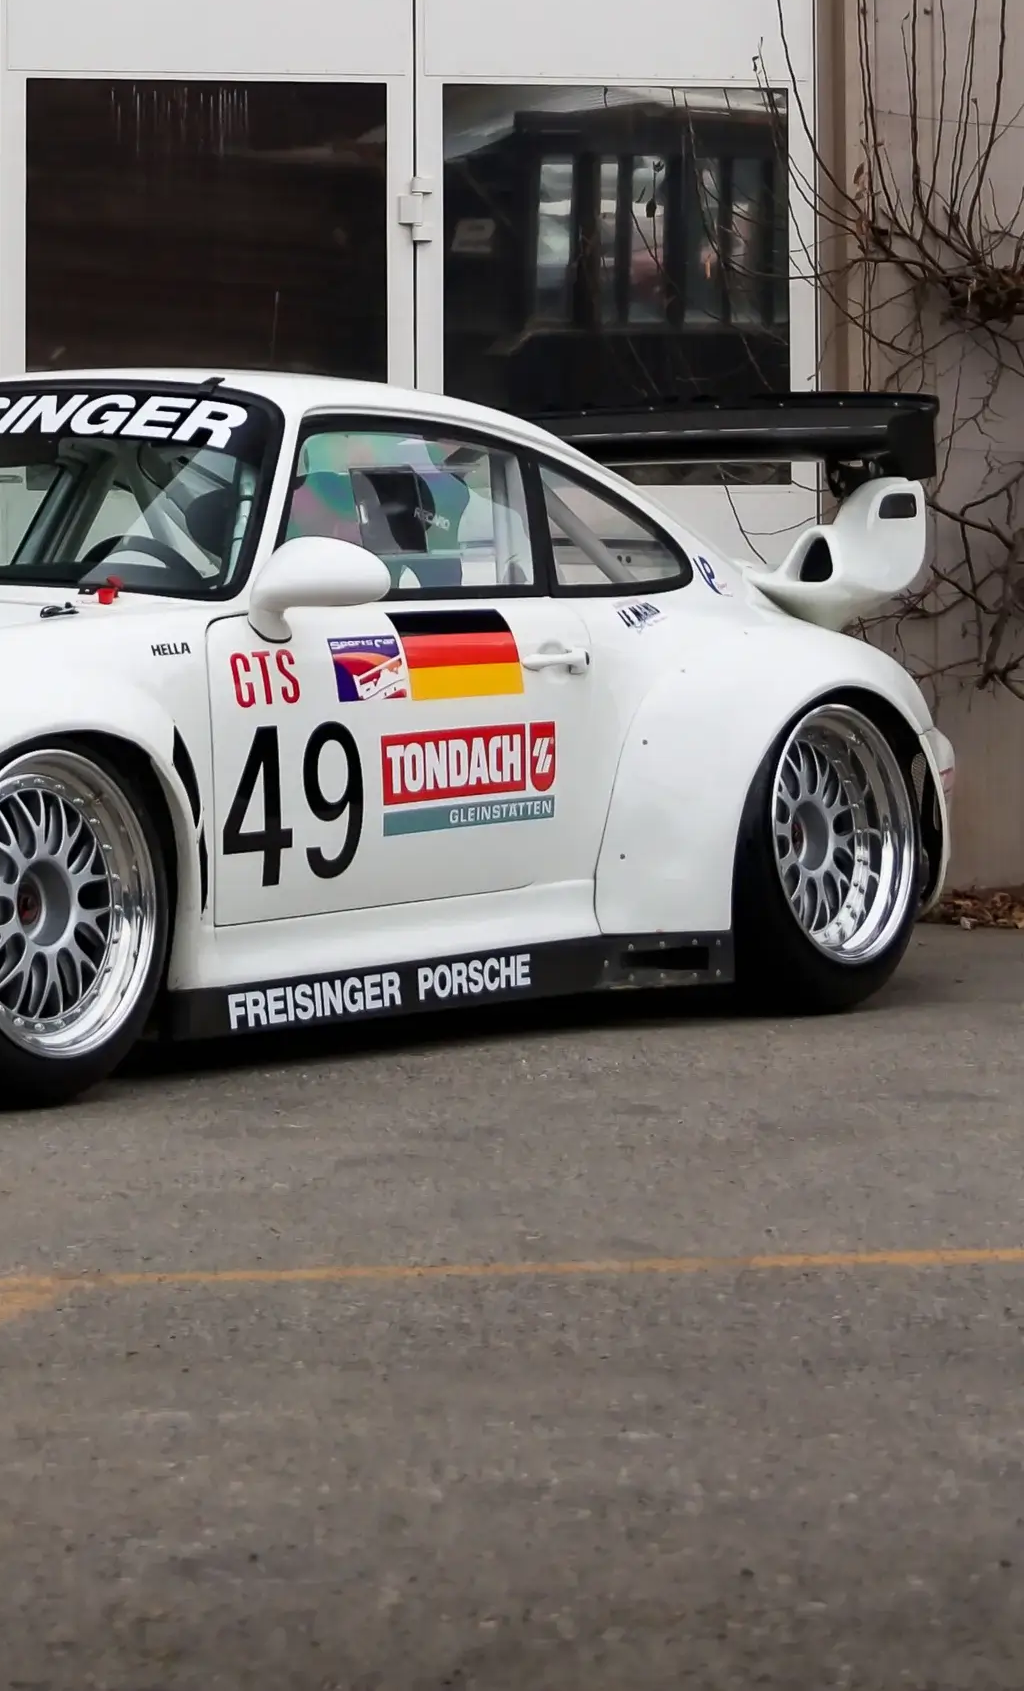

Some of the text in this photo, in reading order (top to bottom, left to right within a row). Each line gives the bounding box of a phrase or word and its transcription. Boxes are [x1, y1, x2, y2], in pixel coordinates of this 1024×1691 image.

[150, 641, 192, 657] HELLA
[230, 649, 300, 708] GTS
[386, 734, 522, 795] TONDACH
[222, 720, 364, 887] 49
[448, 799, 553, 825] GLEINSTÄTTEN
[226, 953, 532, 1029] FREISINGER PORSCHE
